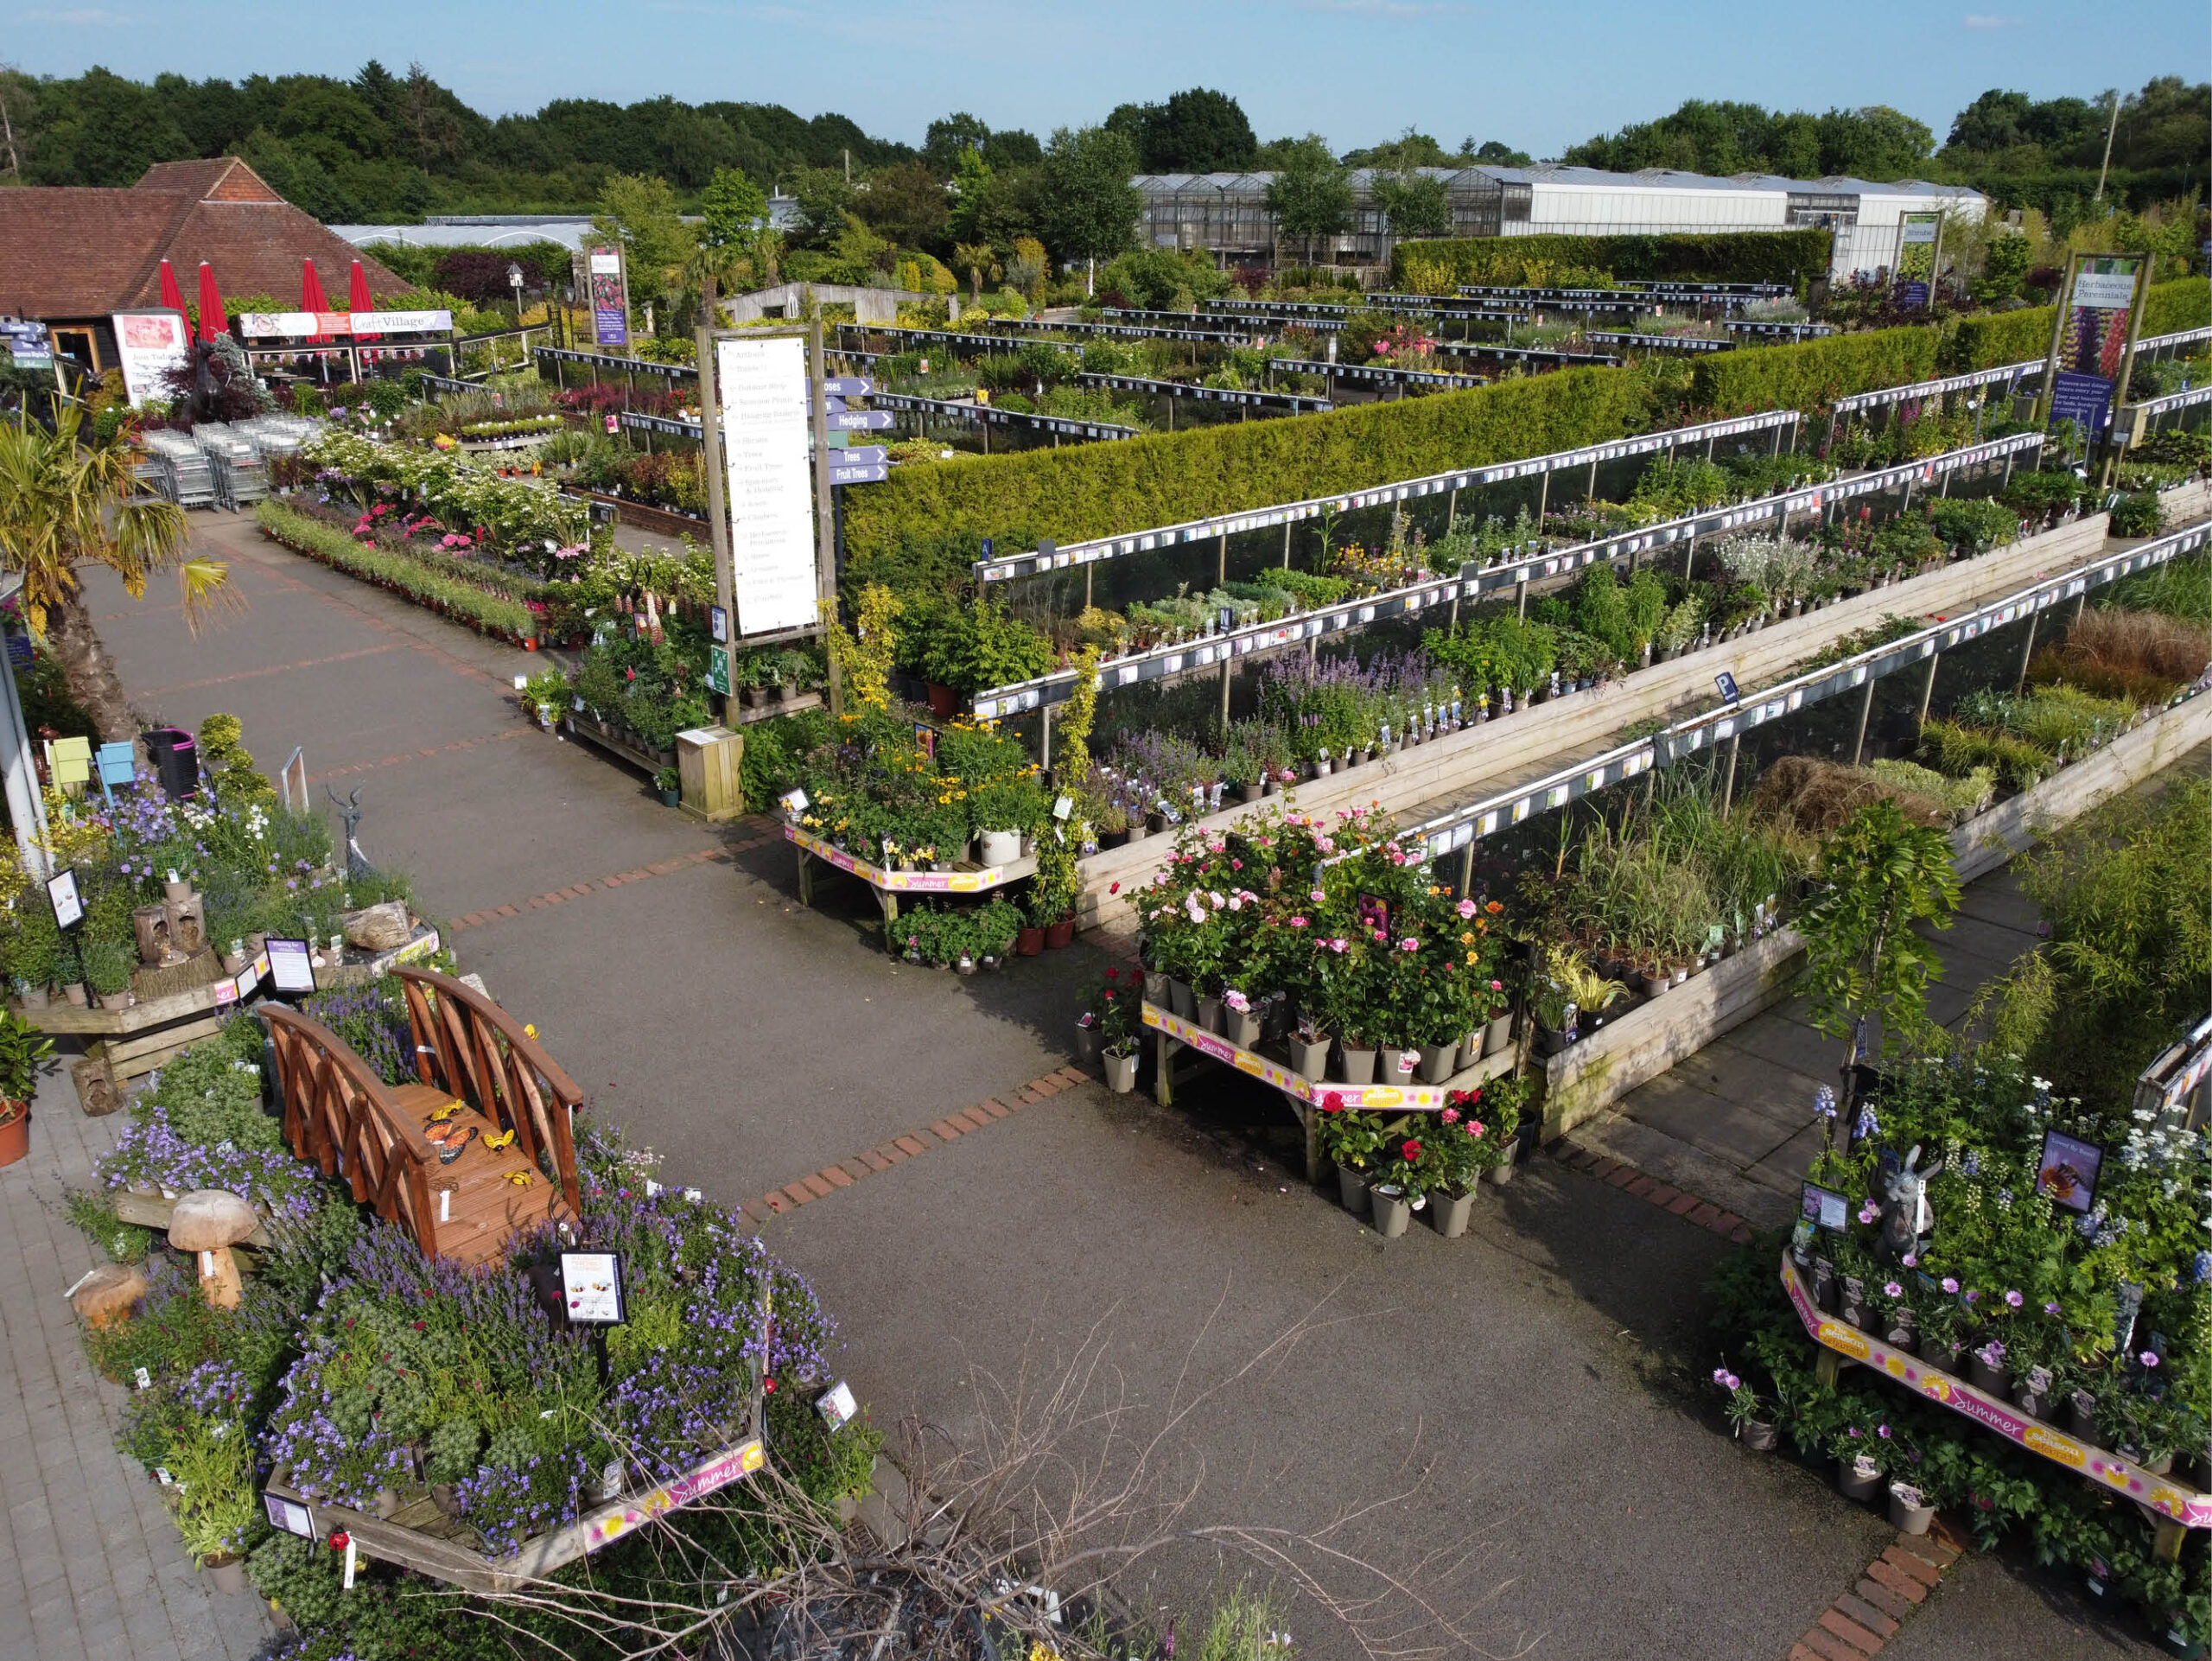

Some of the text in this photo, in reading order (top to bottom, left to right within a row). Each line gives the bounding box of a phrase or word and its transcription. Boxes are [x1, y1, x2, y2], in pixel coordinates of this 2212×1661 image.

[2078, 280, 2132, 290] Herbaceous
[2078, 290, 2127, 299] Perennials
[382, 315, 424, 328] Village
[824, 382, 841, 391] oses
[839, 415, 868, 427] Hedging
[843, 451, 861, 461] Trees
[836, 468, 868, 480] Fruit Trees
[982, 544, 988, 555] A
[1220, 609, 1229, 626] N
[1716, 675, 1729, 696] P
[906, 876, 946, 888] Summer
[1197, 1030, 1231, 1060] Summer
[1951, 1384, 2022, 1435] Summer
[2031, 1433, 2079, 1456] season
[671, 1462, 738, 1506] Summer
